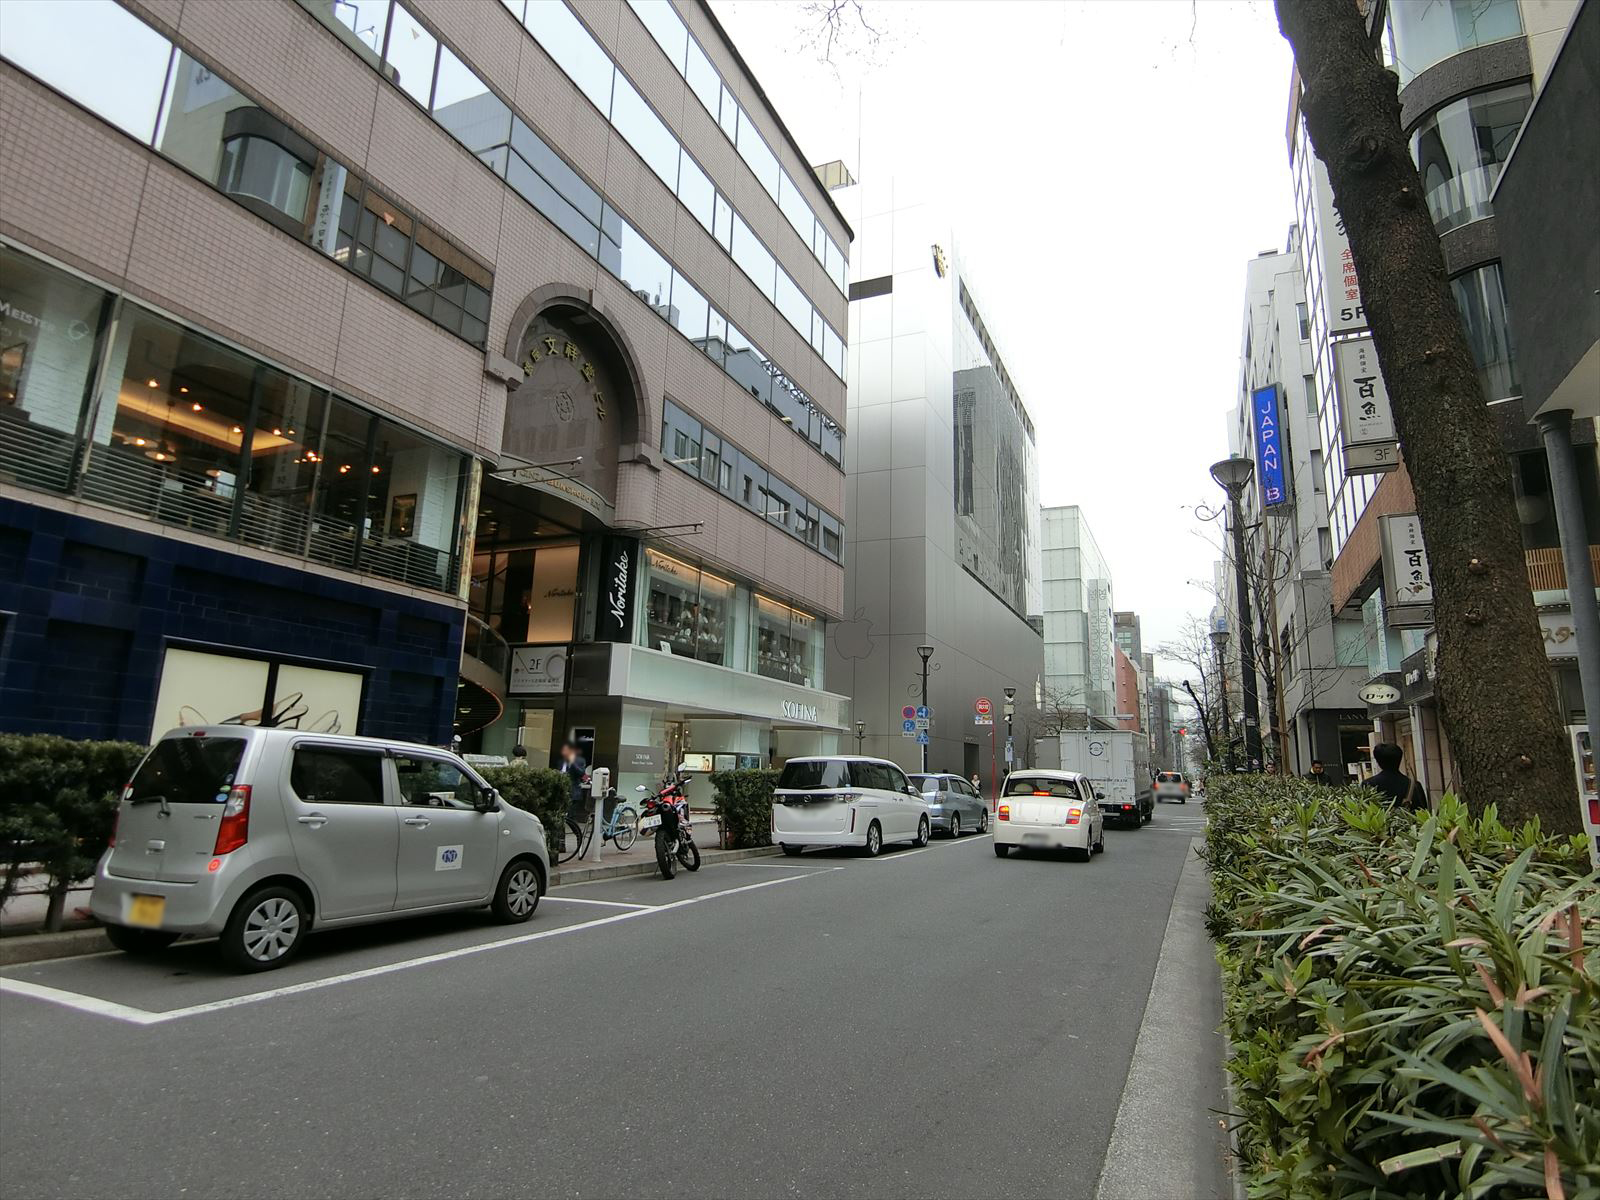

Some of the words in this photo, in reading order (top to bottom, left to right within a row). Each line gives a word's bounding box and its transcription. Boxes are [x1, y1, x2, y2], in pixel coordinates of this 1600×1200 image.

[1352, 375, 1381, 421] 百魚
[1261, 400, 1278, 472] JAPAN
[1374, 447, 1391, 461] 3F
[609, 551, 629, 629] Noritake
[529, 658, 542, 670] 2F
[782, 700, 817, 722] SOFINA
